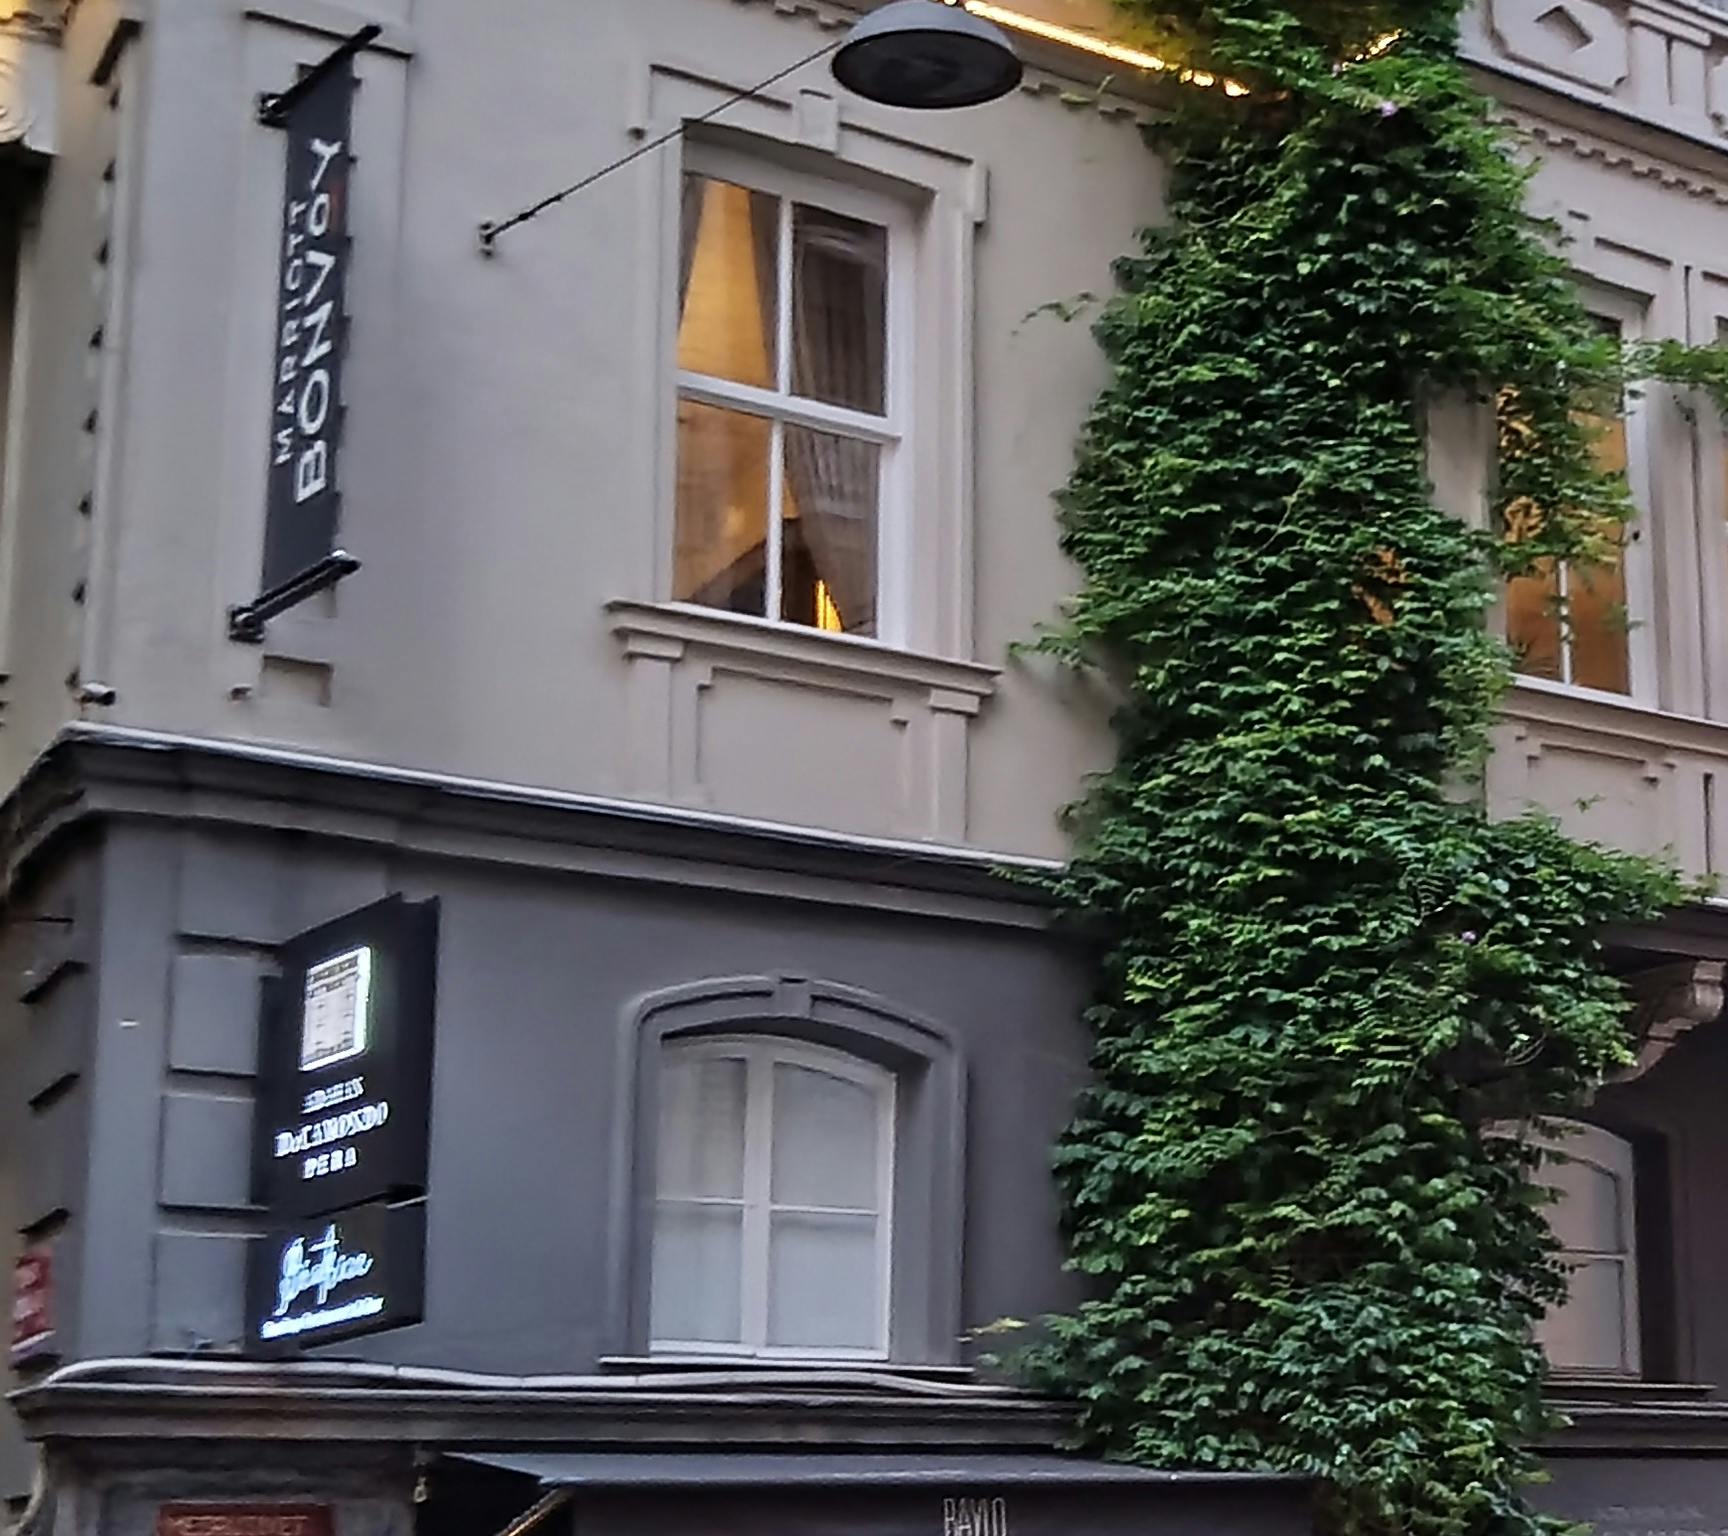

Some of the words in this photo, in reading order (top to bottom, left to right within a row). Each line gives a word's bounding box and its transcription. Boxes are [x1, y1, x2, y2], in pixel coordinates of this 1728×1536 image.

[274, 199, 310, 466] MARRIOTT
[296, 138, 341, 504] BONVOY
[303, 1146, 357, 1181] PERA
